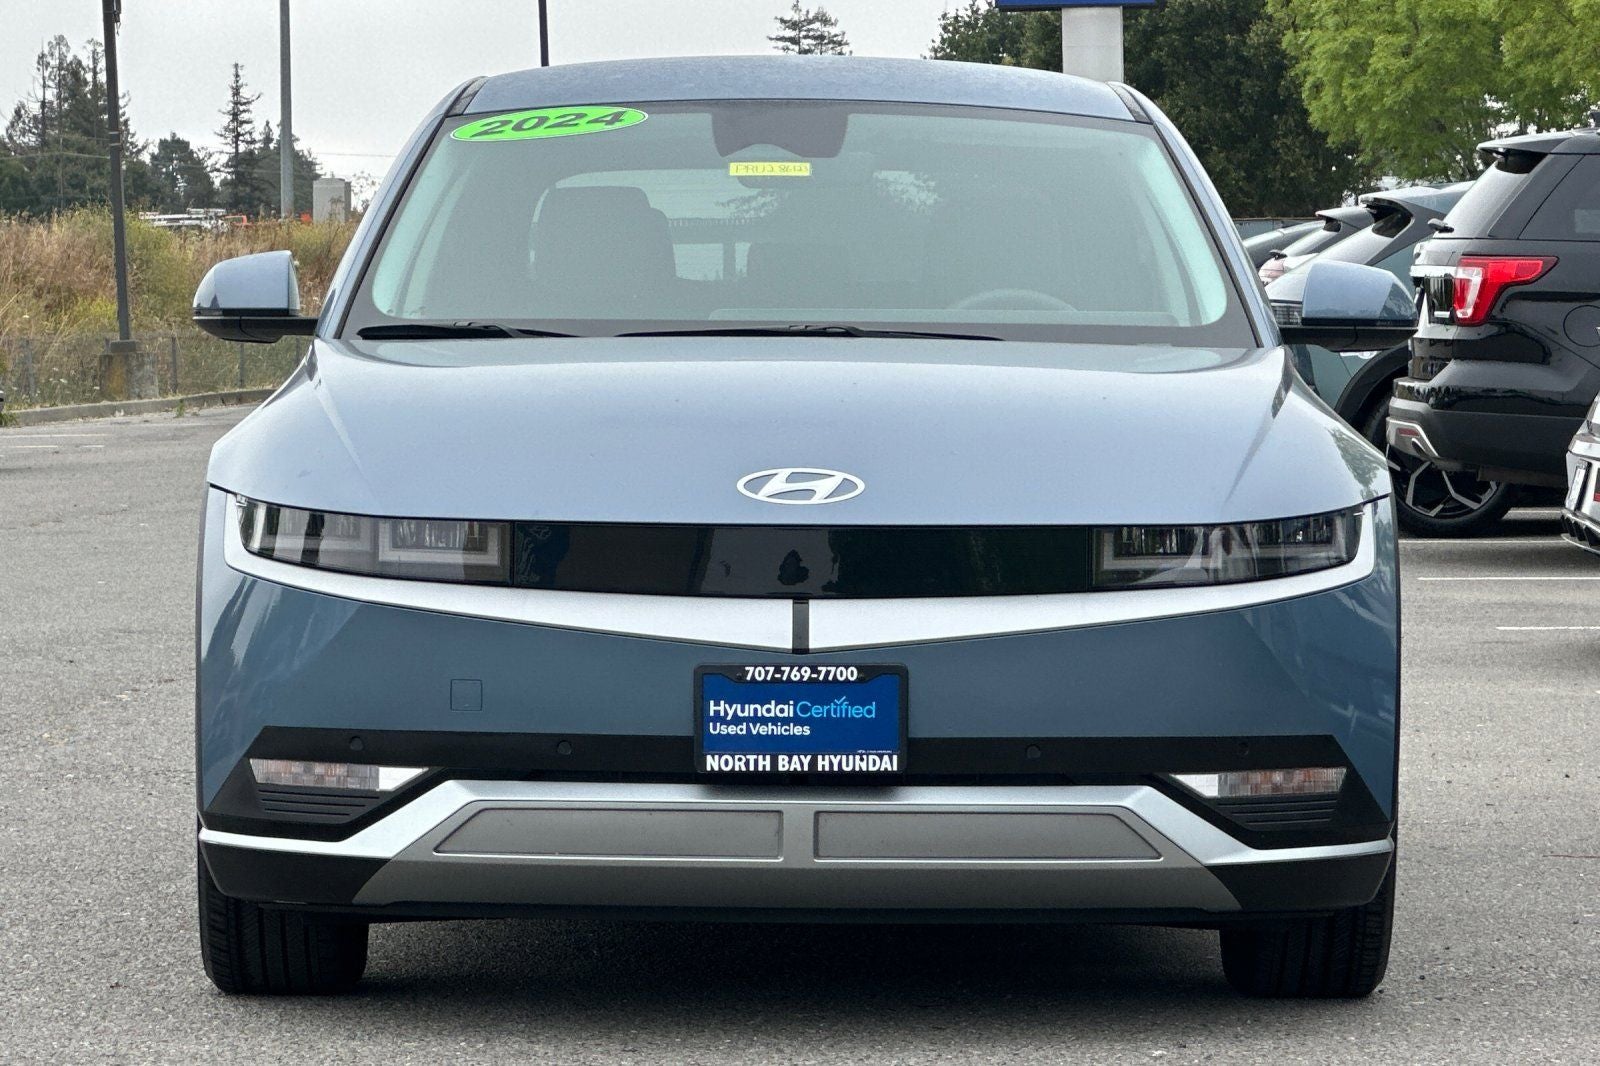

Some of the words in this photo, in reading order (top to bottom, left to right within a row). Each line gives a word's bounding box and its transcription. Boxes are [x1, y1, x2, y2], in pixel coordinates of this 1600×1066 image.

[469, 110, 627, 138] 2024
[744, 666, 858, 681] 707-769-7700
[709, 700, 794, 720] Hyundai
[796, 696, 876, 718] Certified
[709, 722, 746, 735] Used
[749, 722, 811, 735] Vehicles
[706, 754, 771, 771] NORTH
[778, 754, 811, 771] BAY
[817, 754, 898, 771] HYUNDAI
